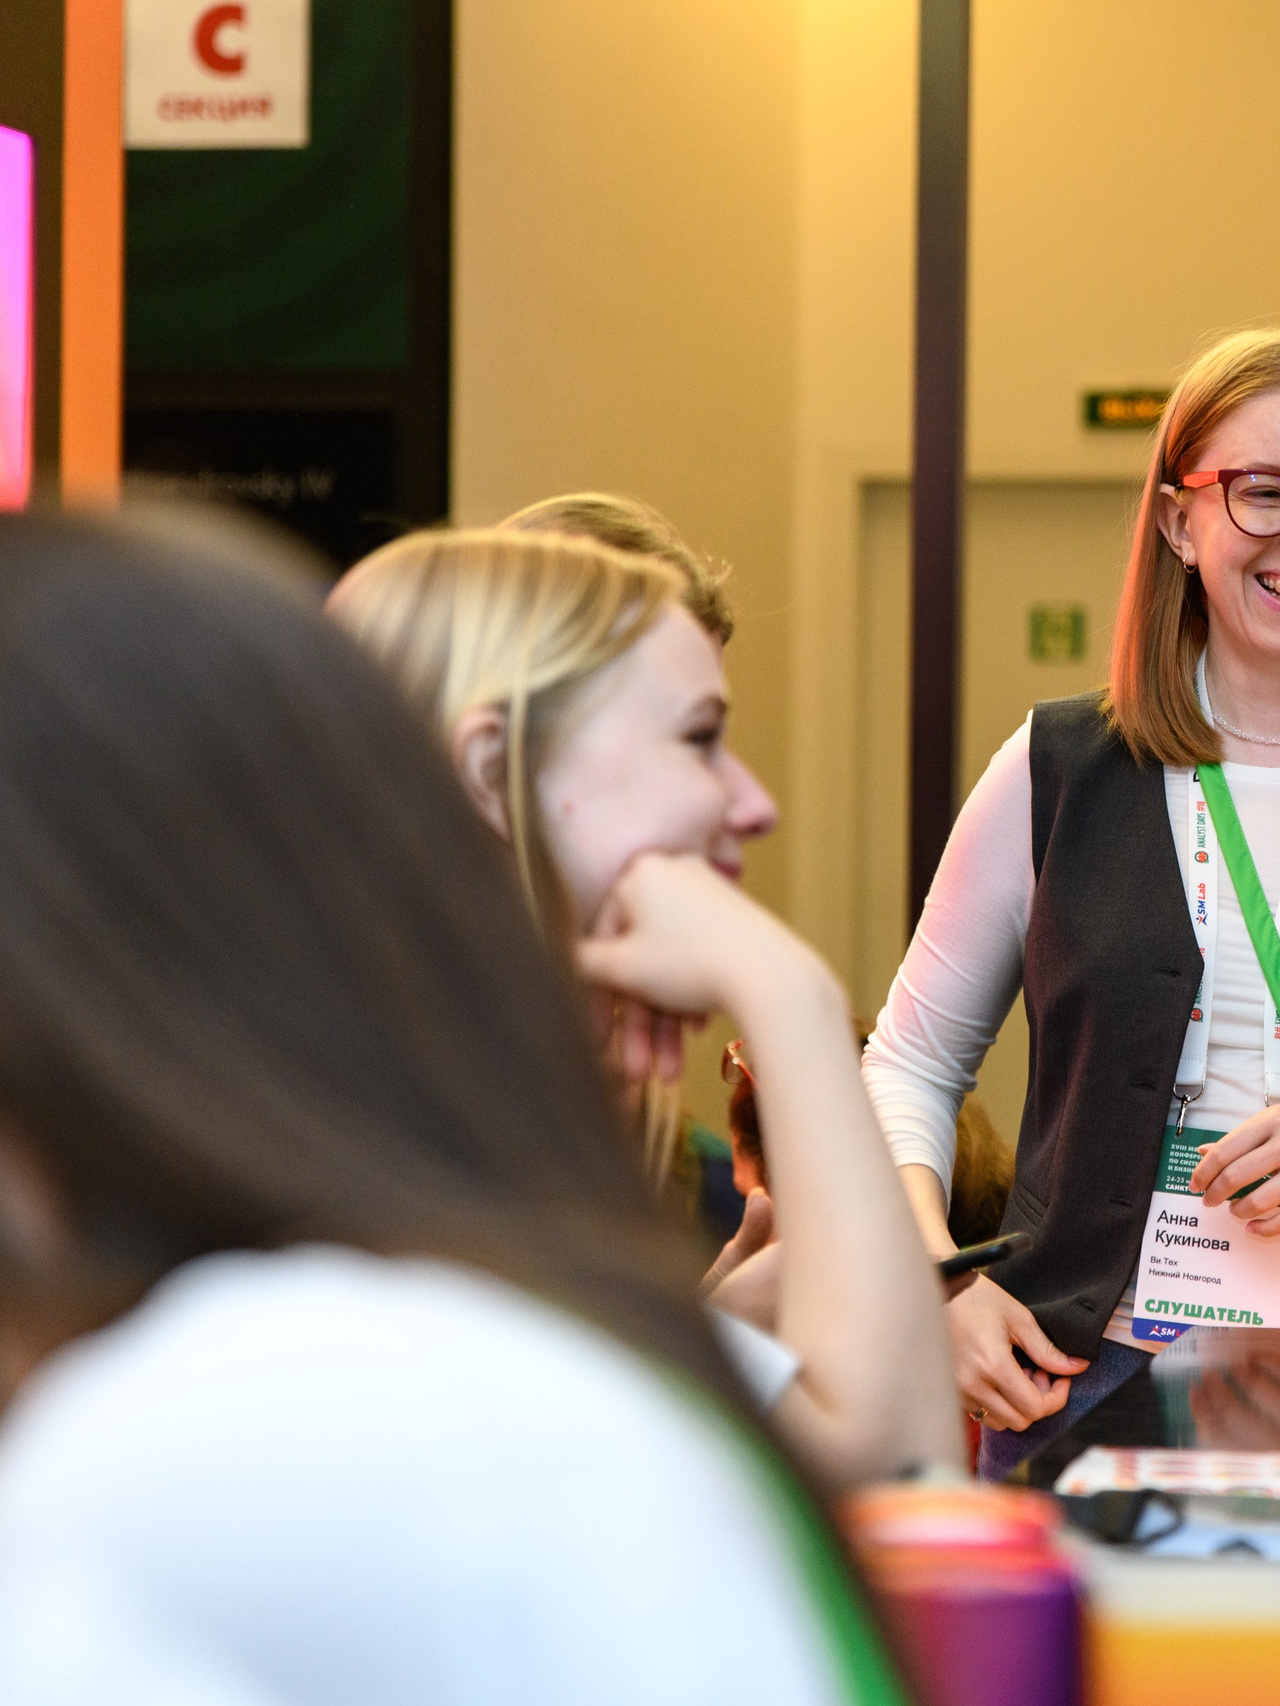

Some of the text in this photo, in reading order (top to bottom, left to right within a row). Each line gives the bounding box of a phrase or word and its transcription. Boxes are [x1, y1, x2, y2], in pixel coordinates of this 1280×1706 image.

[1196, 800, 1206, 848] ANALYST DAYS #18
[1197, 883, 1206, 915] SM Lab
[1169, 1151, 1203, 1159] КОНФЕРЕ
[1166, 1175, 1185, 1183] 24-25
[1157, 1210, 1198, 1227] Анна
[1155, 1229, 1230, 1251] Кукинова
[1149, 1268, 1222, 1285] Нижний Новгород
[1144, 1299, 1264, 1326] СЛУШАТЕЛЬ
[1160, 1327, 1176, 1337] SM
